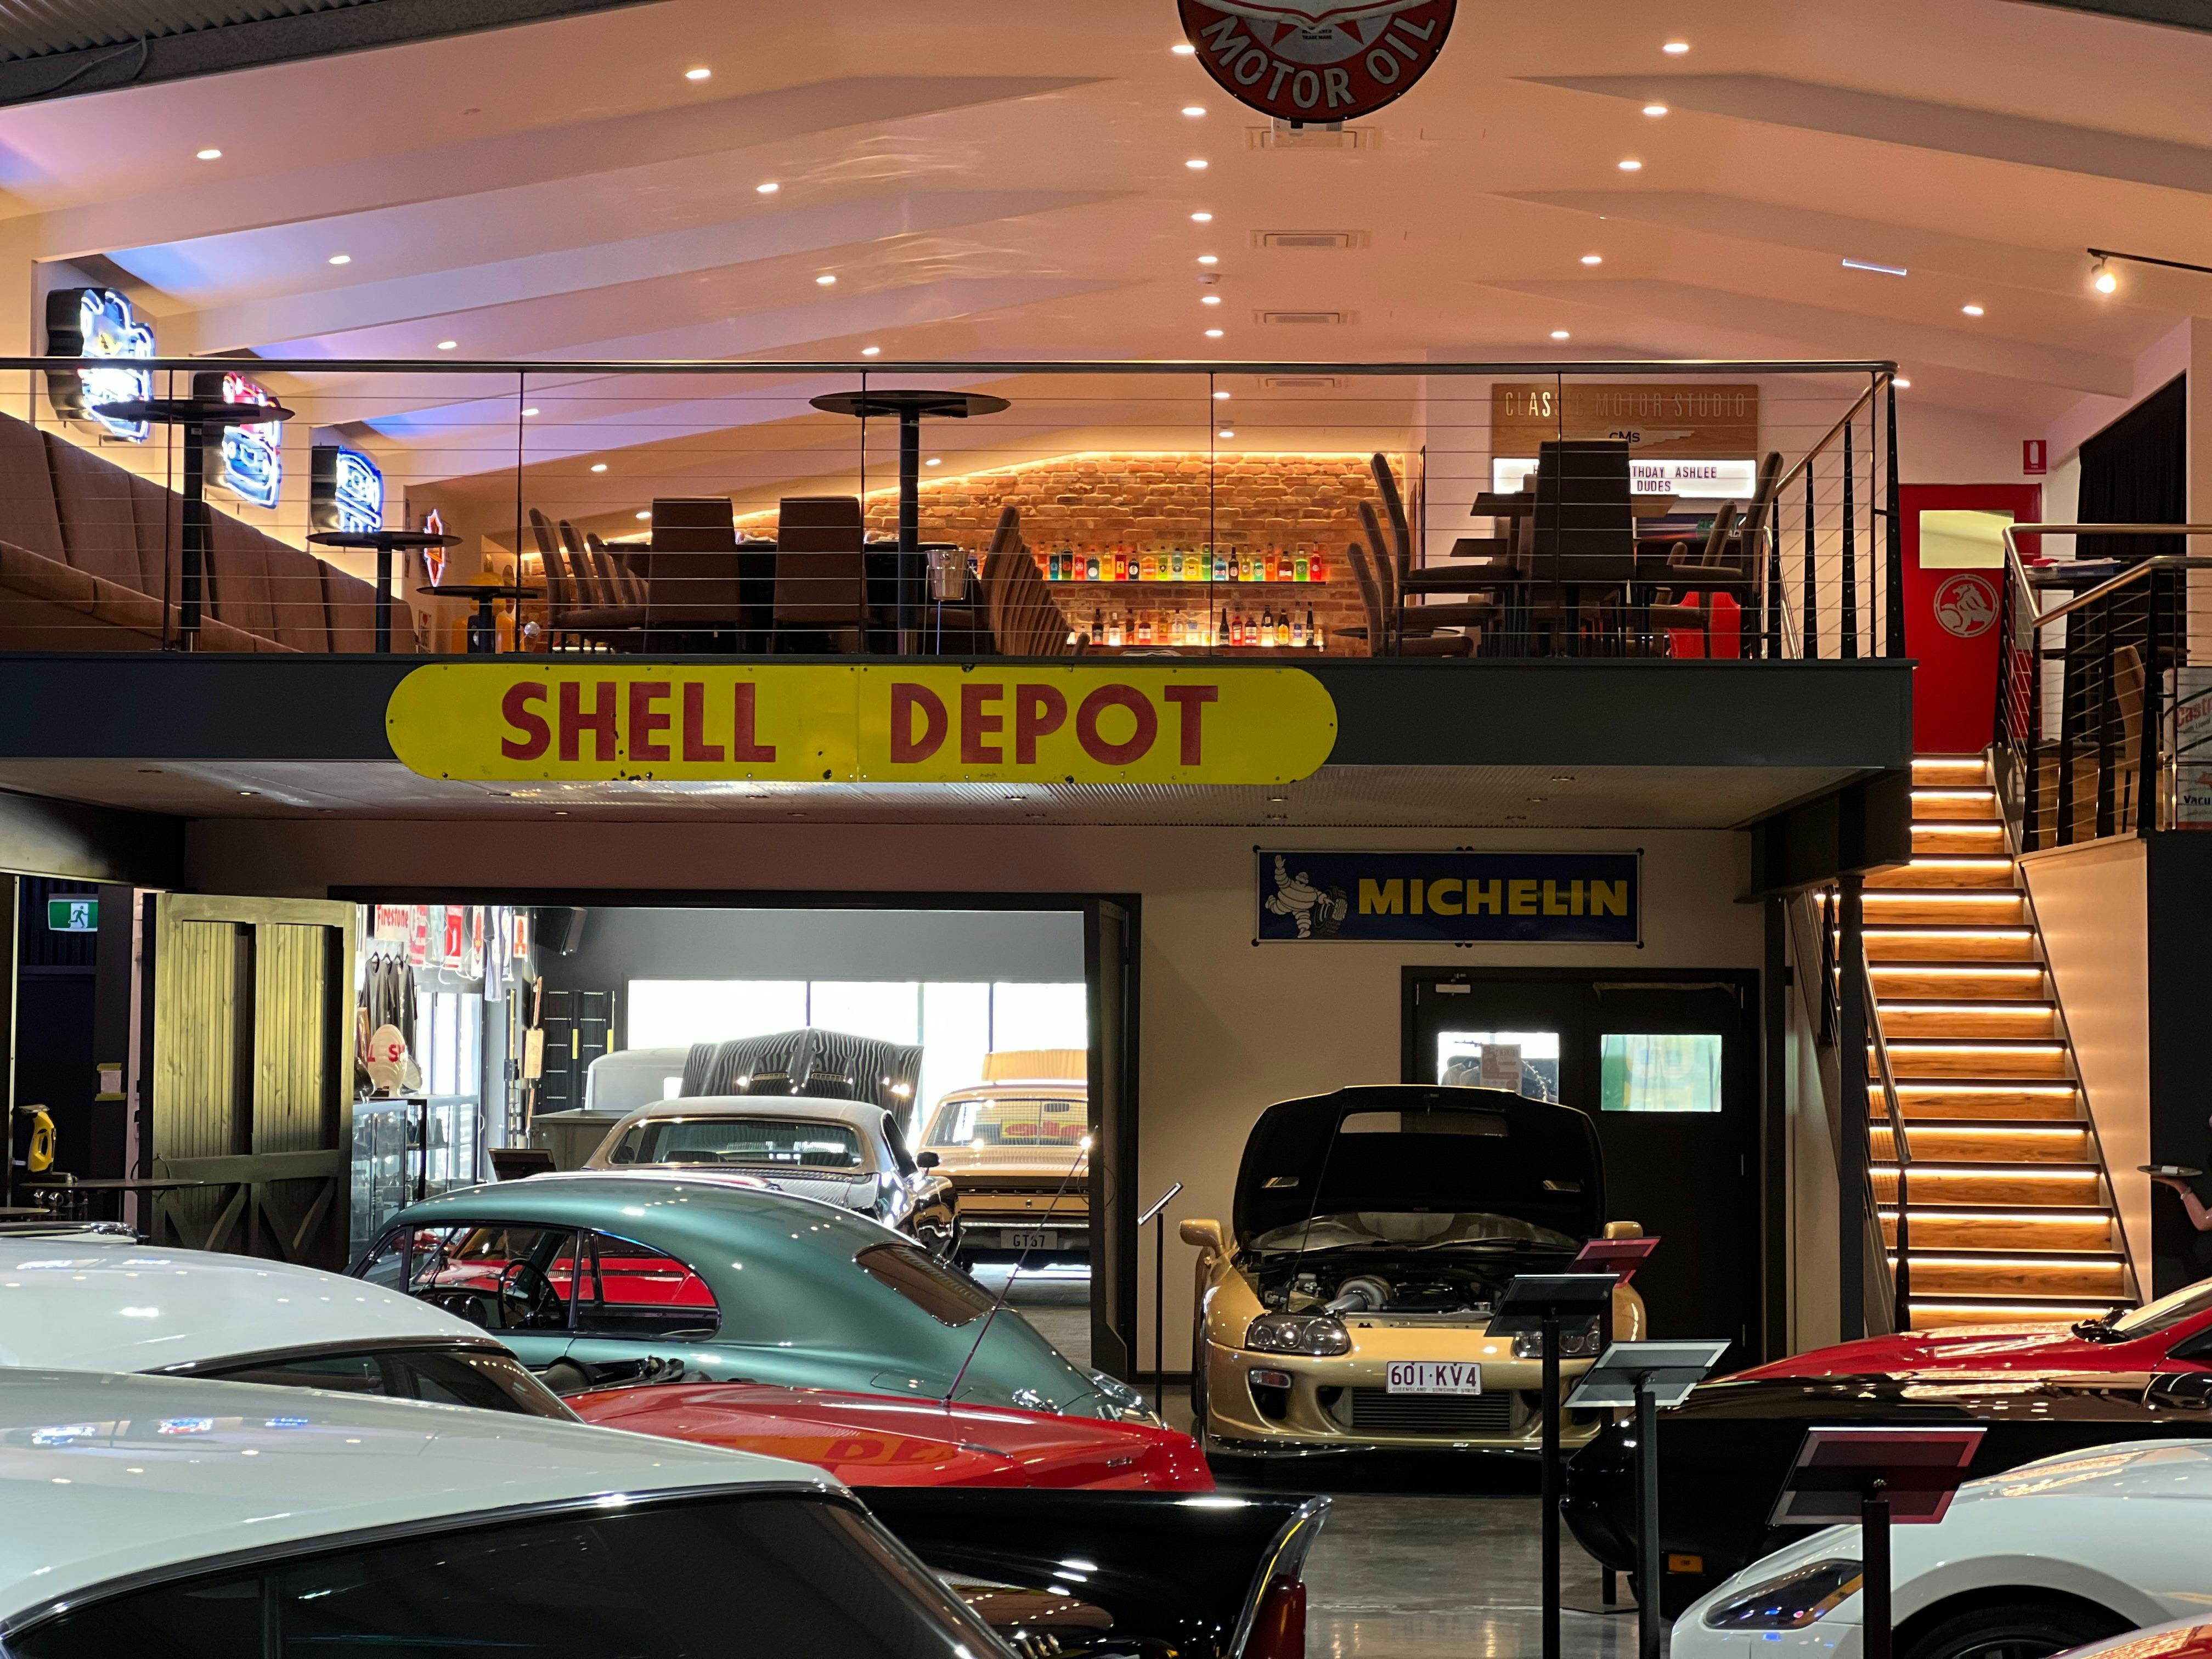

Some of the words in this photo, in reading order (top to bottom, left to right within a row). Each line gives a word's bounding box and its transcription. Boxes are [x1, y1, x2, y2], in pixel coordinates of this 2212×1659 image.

[1200, 15, 1356, 109] MOTOR
[1366, 16, 1436, 84] OIL
[1595, 392, 1662, 417] MOTOR
[1674, 392, 1745, 417] STUDIO
[1609, 431, 1640, 443] CMS
[1632, 466, 1665, 478] THDAY
[1675, 466, 1717, 479] ASHLEE
[1637, 480, 1671, 492] DUDES
[502, 682, 775, 762] SHELL
[891, 684, 1218, 765] DEPOT
[1359, 878, 1628, 916] MICHELIN
[377, 905, 409, 932] Firestone
